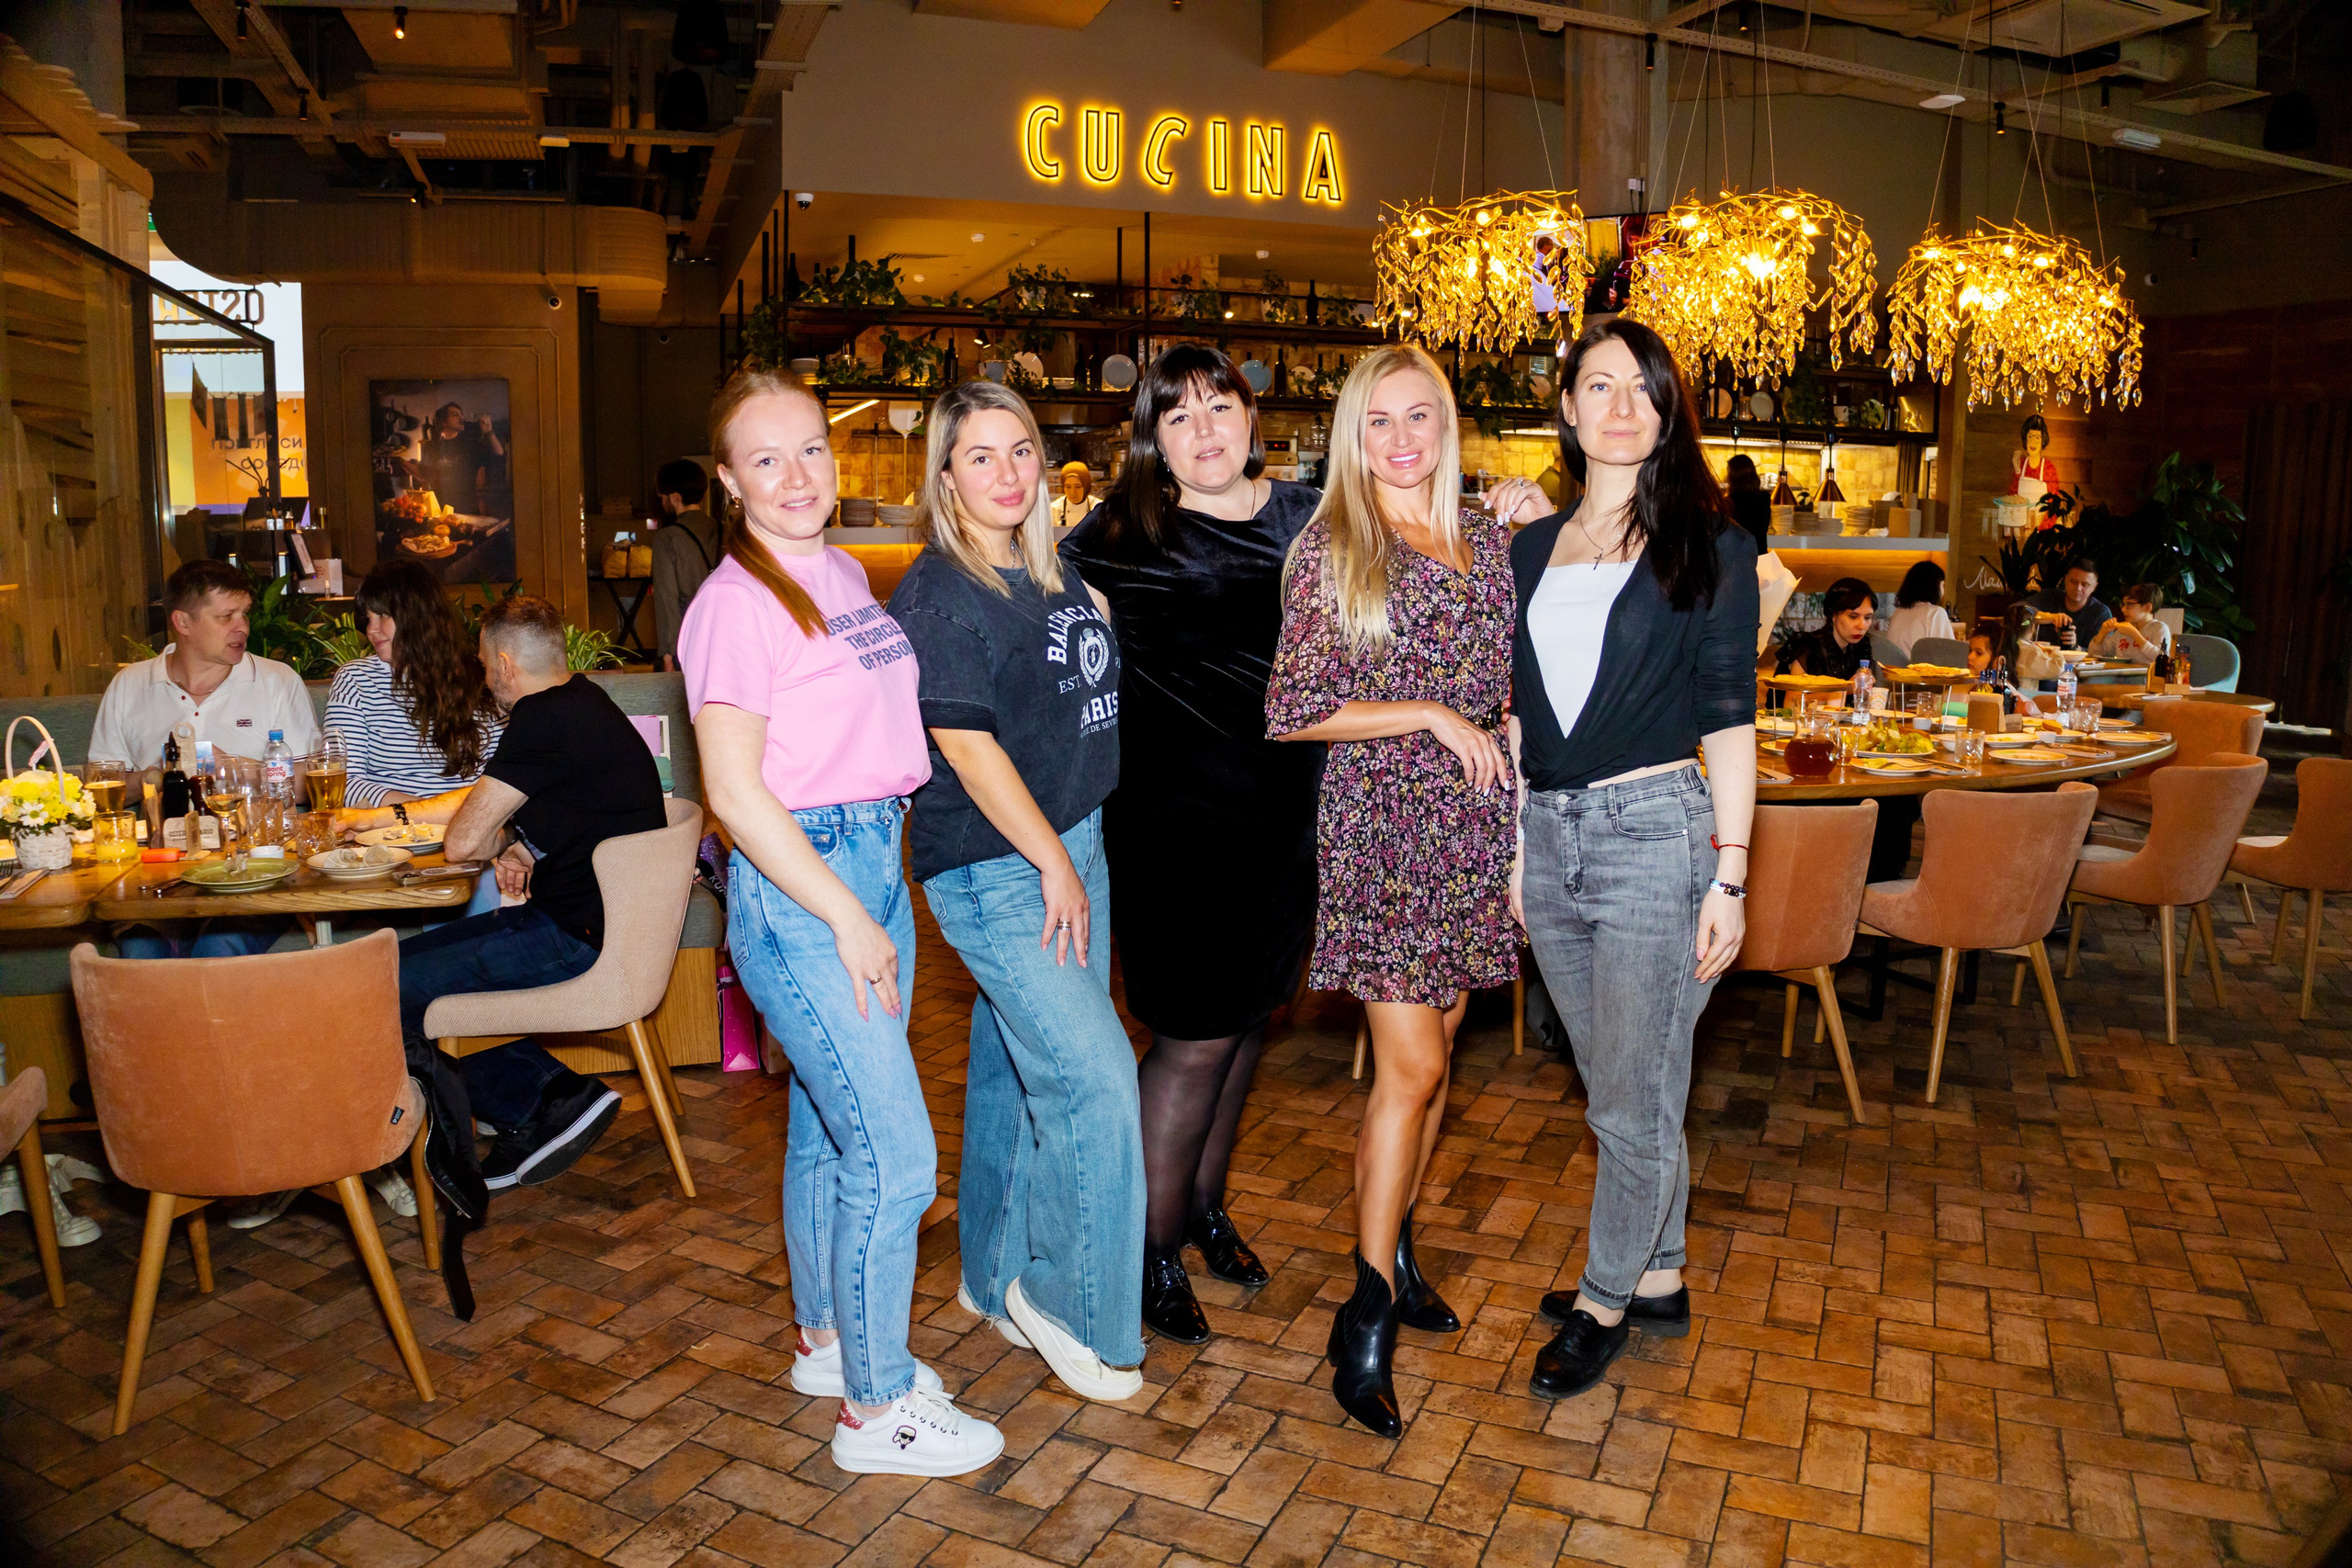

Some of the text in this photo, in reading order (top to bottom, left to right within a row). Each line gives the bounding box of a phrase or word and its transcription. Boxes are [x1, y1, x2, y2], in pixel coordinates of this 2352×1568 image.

[1024, 102, 1344, 203] CUCINA
[824, 614, 857, 637] USER
[843, 621, 904, 650] THE CIRCLE
[1046, 605, 1118, 665] BALENCIA
[858, 653, 876, 671] OF
[1090, 723, 1102, 733] DE
